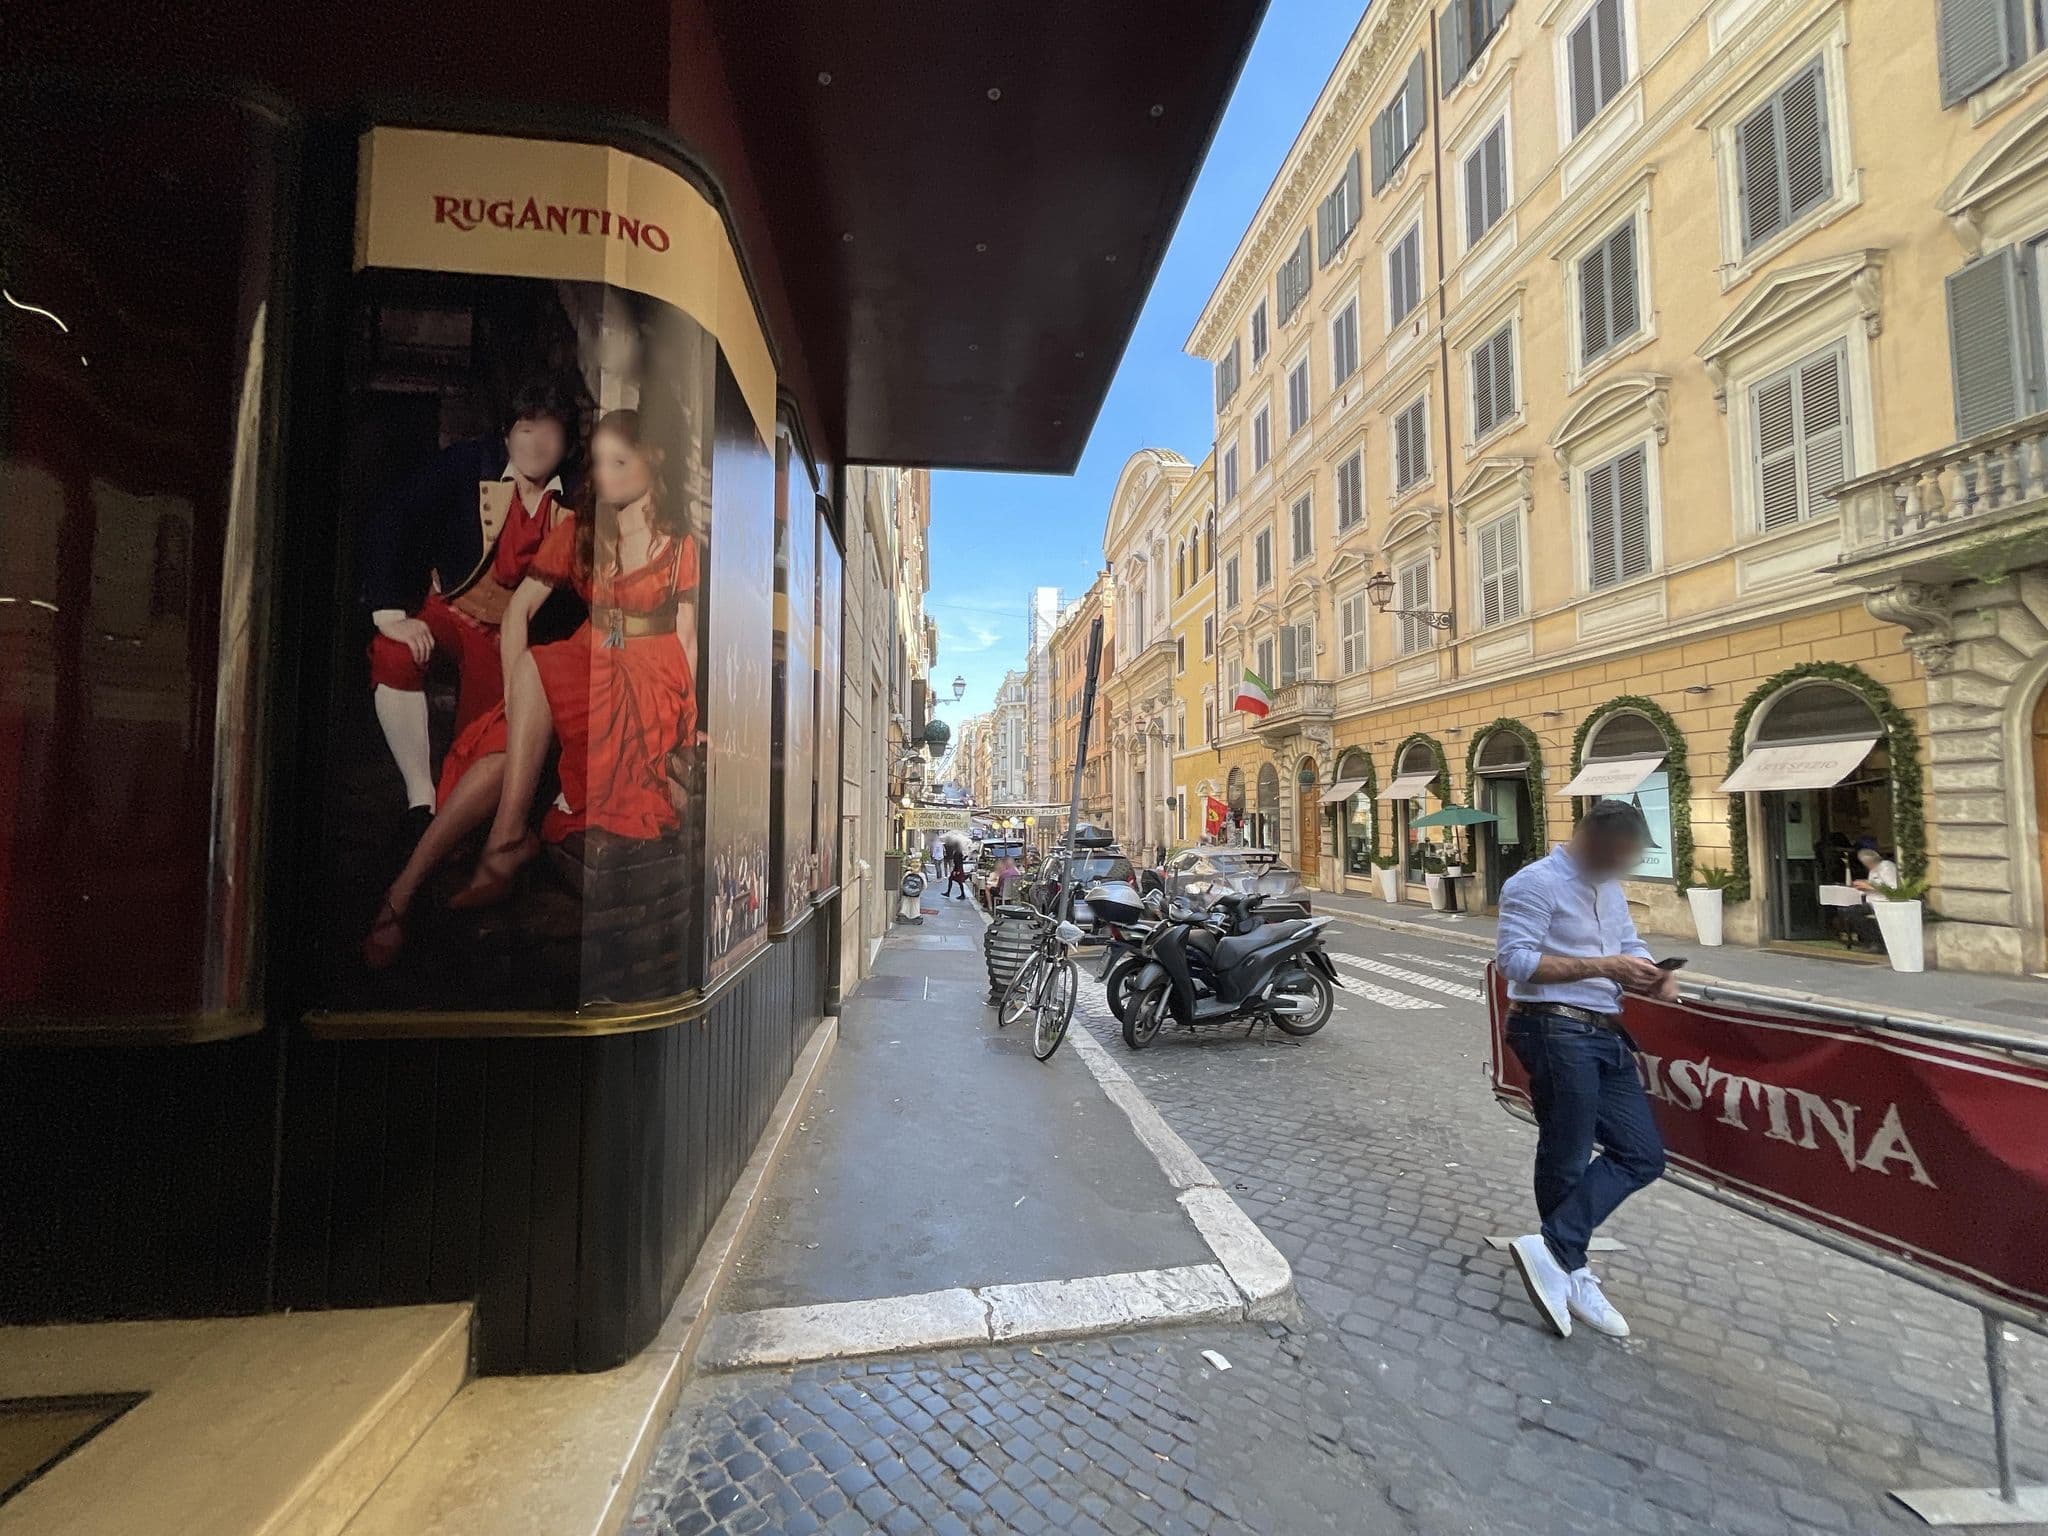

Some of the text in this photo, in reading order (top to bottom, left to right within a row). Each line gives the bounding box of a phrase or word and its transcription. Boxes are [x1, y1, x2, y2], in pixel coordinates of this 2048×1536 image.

[433, 195, 671, 253] RUGANTINO
[1041, 807, 1070, 816] PIZZERI
[918, 819, 941, 828] Botte
